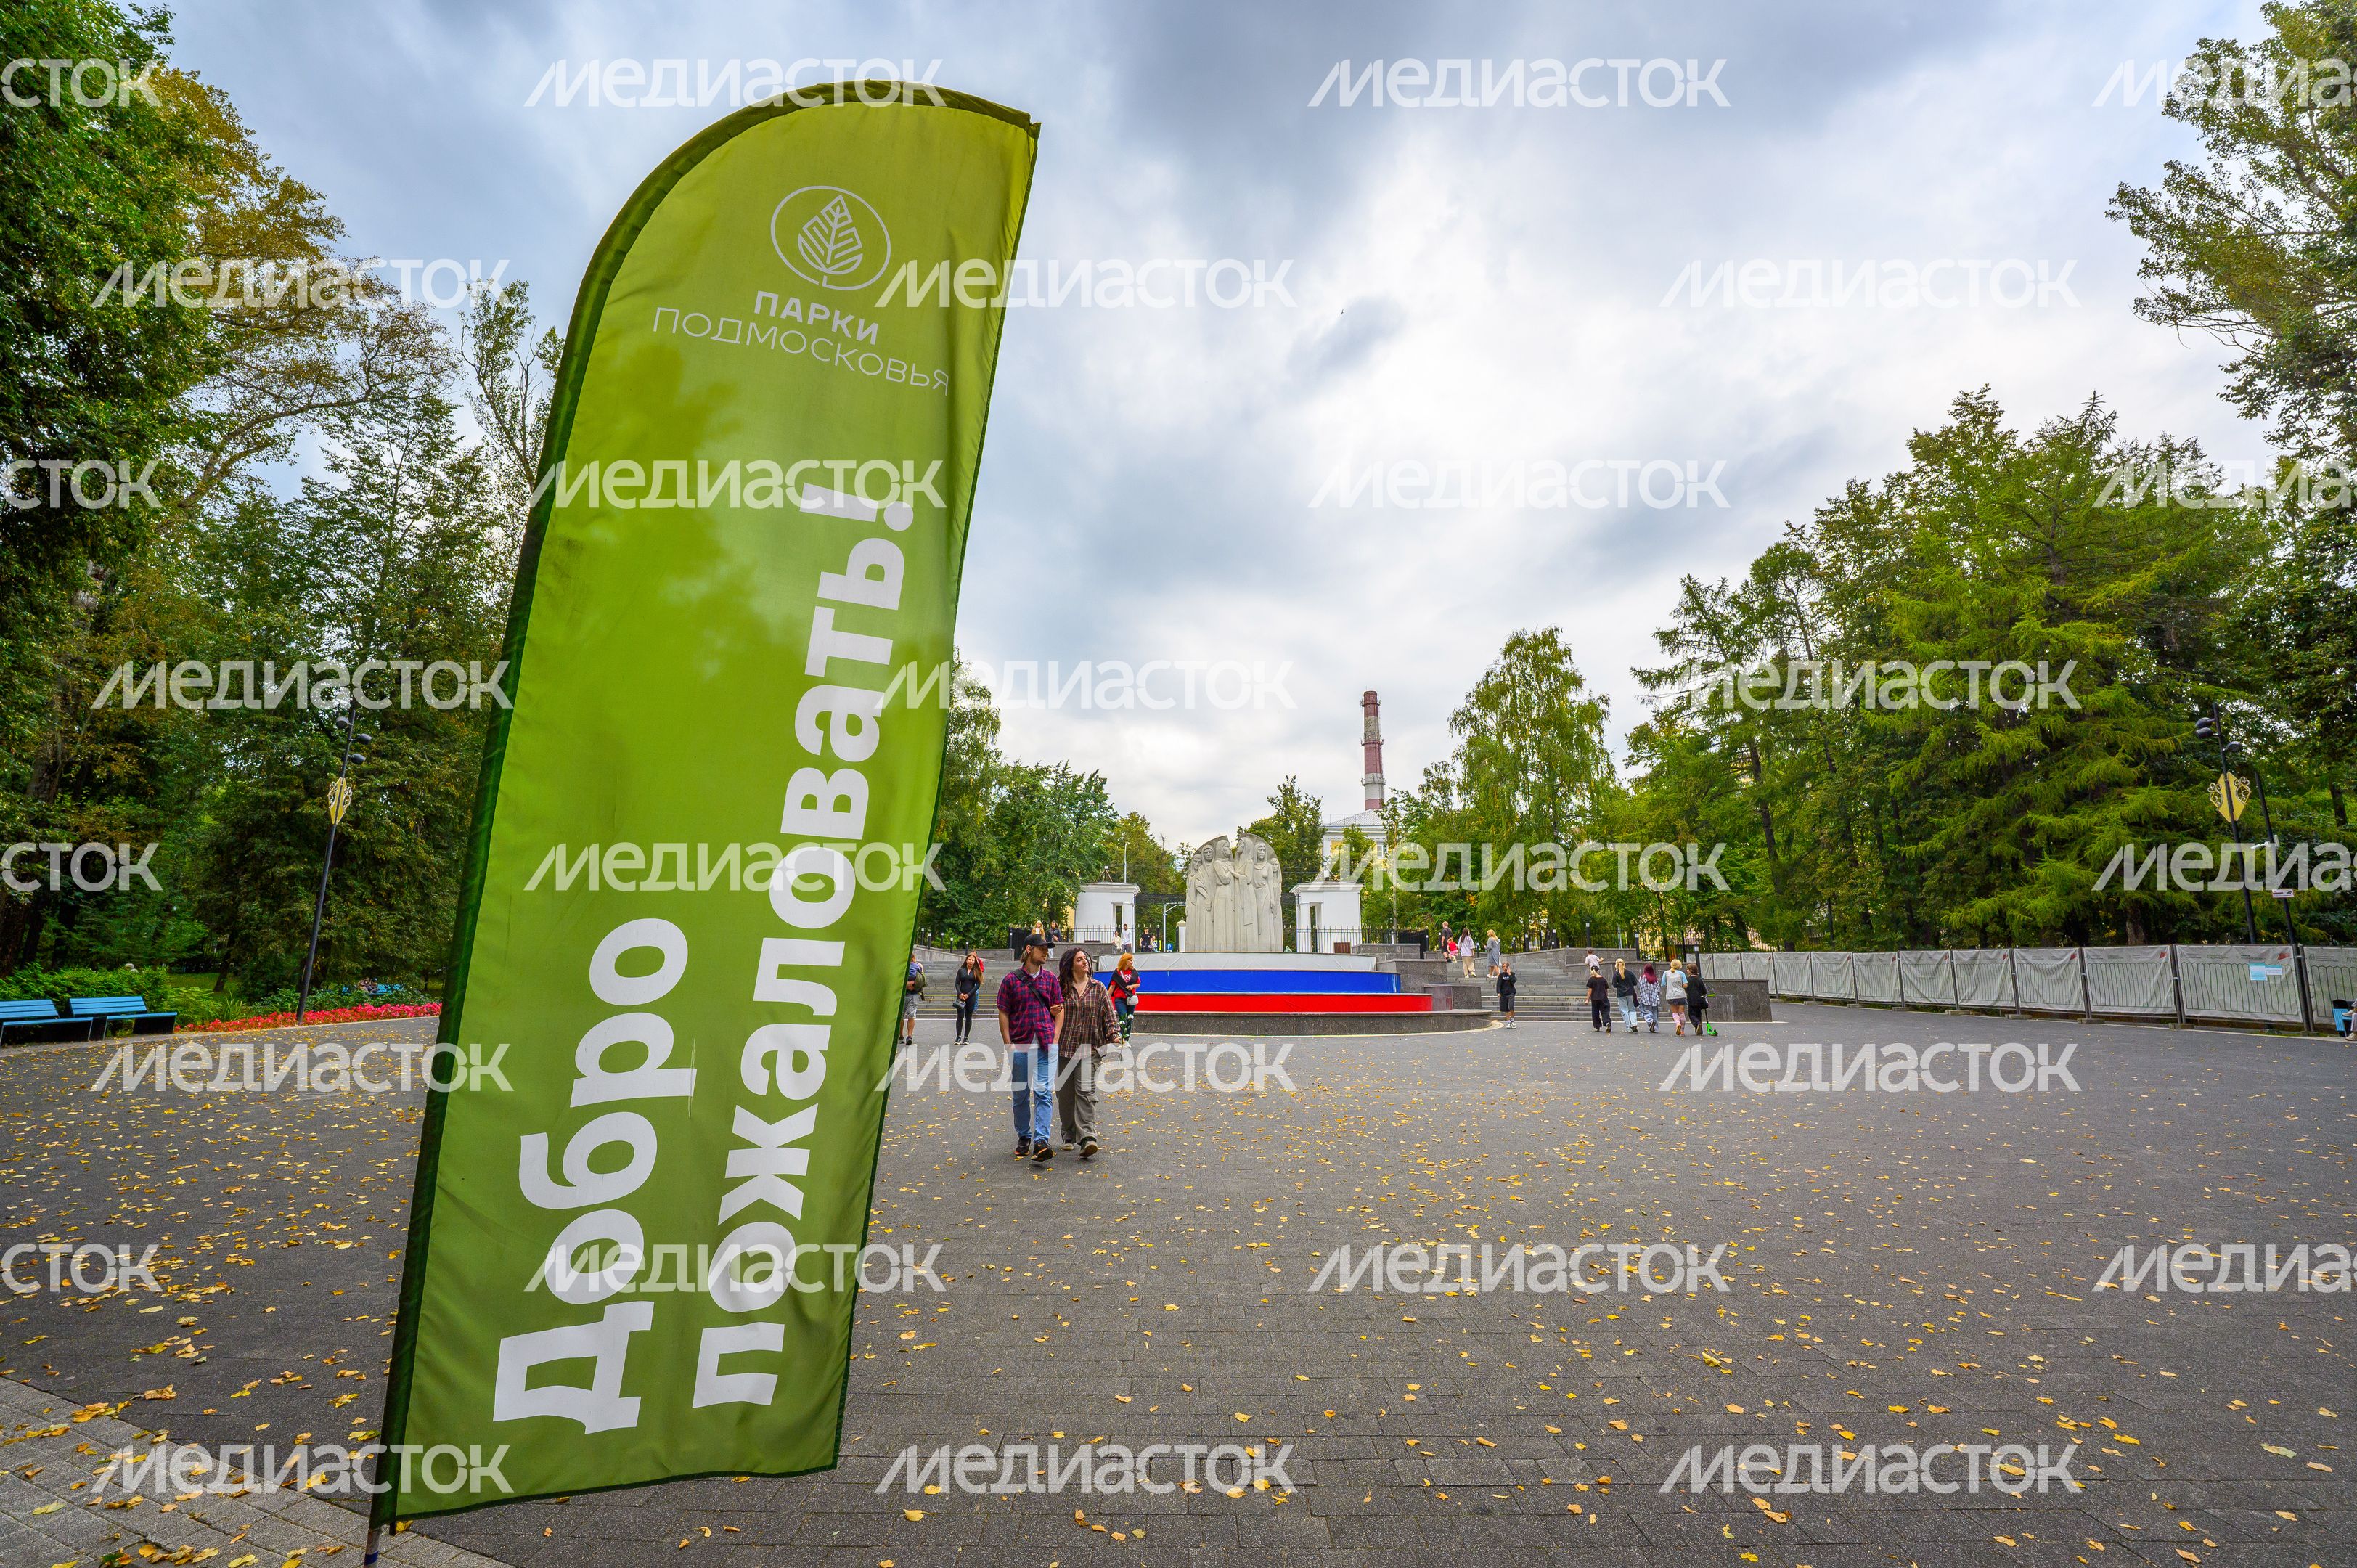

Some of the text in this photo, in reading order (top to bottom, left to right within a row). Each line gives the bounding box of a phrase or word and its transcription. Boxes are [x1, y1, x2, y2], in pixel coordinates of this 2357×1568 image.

[653, 307, 948, 395] ПОДМОСКОВЬЯ
[754, 290, 878, 345] ПАРКИ
[693, 482, 914, 1408] пожаловать!
[493, 918, 697, 1434] Добро
